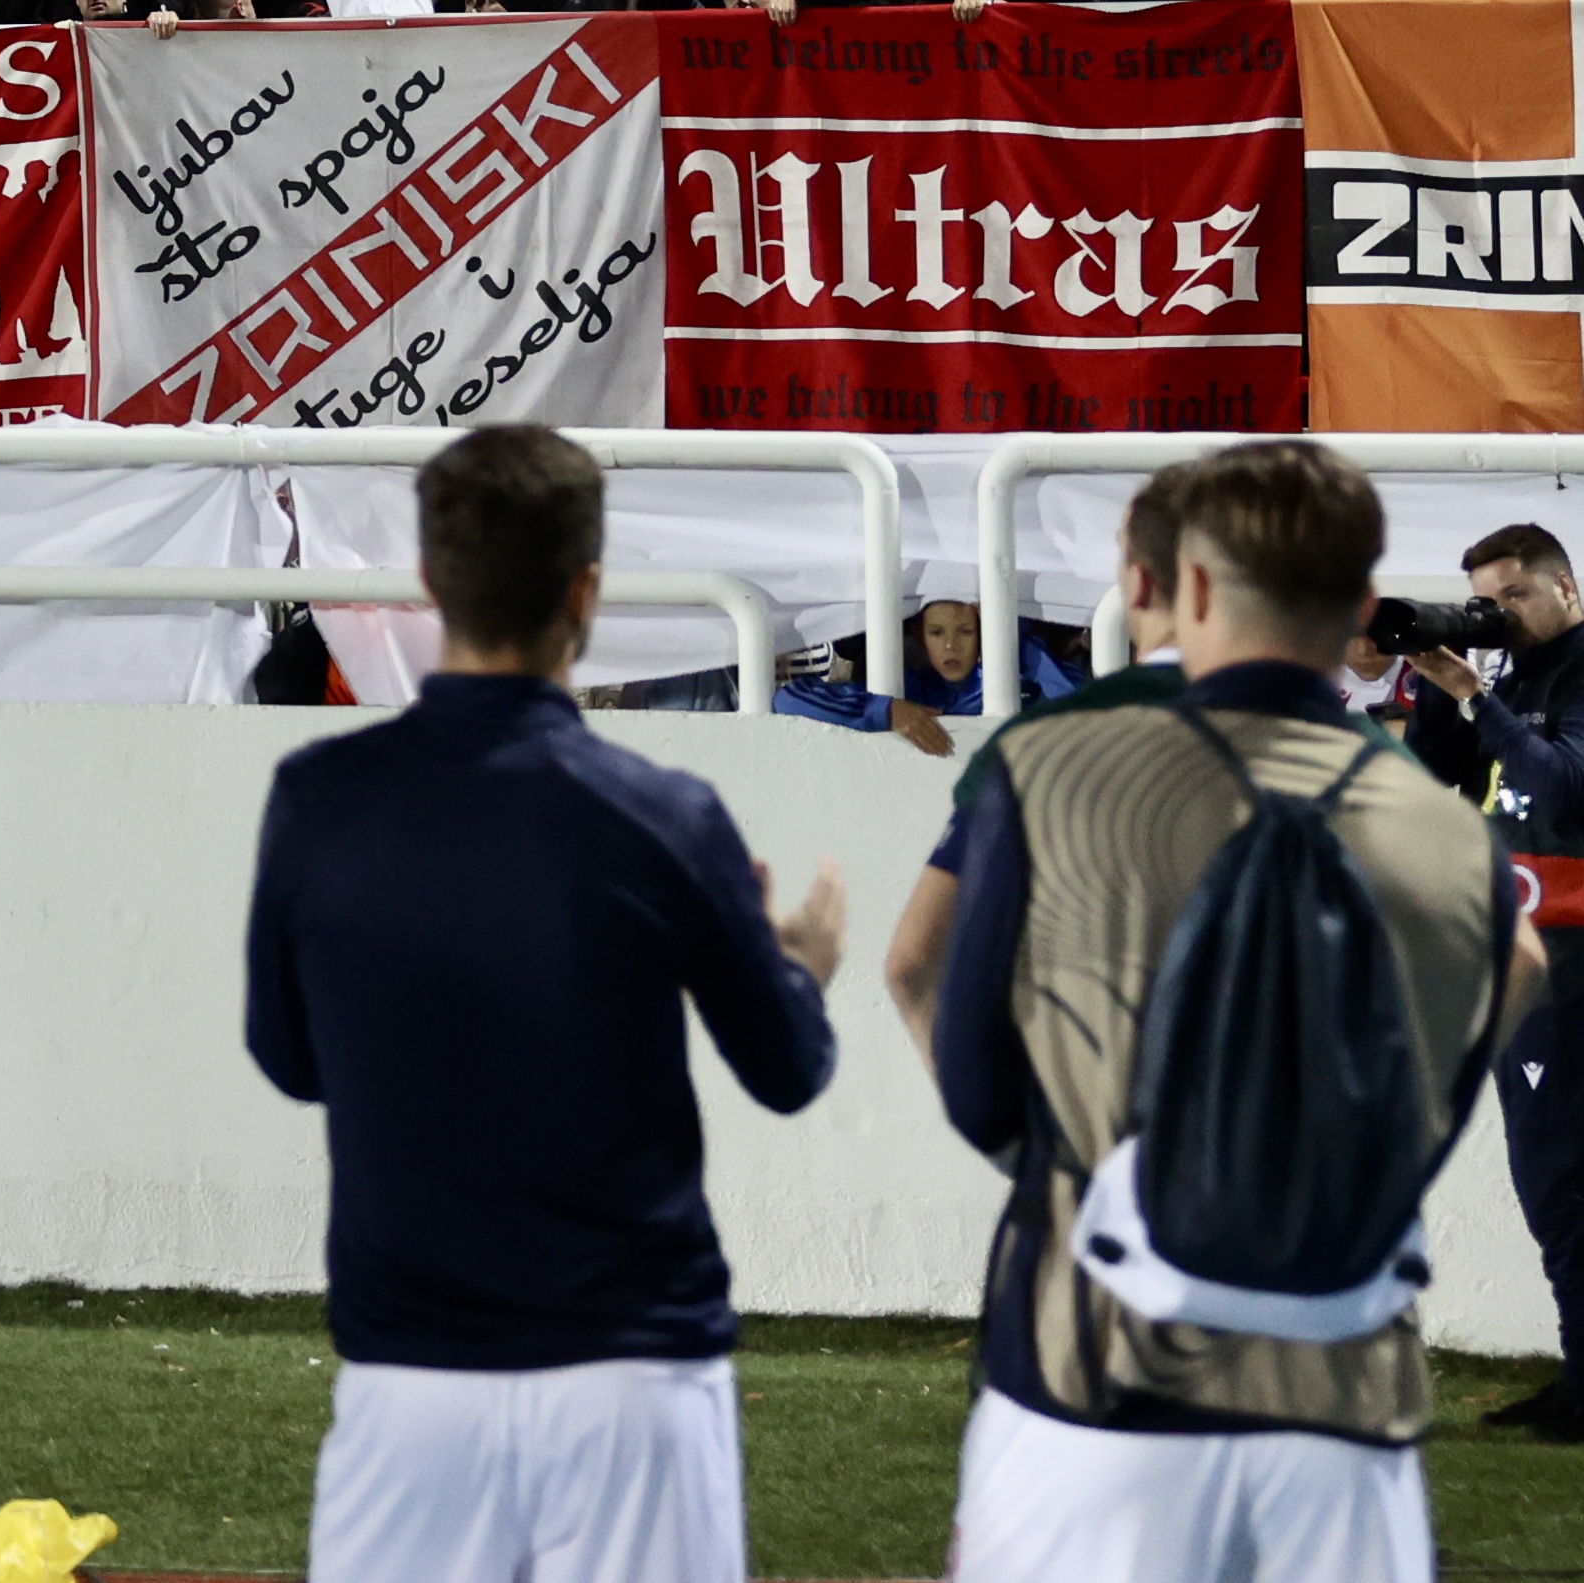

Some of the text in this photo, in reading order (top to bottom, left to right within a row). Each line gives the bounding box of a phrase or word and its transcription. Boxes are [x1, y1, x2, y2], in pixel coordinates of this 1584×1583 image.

[683, 26, 1285, 86] we belong to the streets
[113, 70, 295, 237] ljubav
[135, 65, 445, 305] što spaja
[160, 41, 623, 424] ZRINJSKI
[677, 148, 1262, 318] Ultras
[292, 328, 445, 428] tuge
[698, 383, 768, 419] we
[786, 373, 938, 430] belong
[960, 380, 1004, 424] to
[1025, 381, 1102, 429] the
